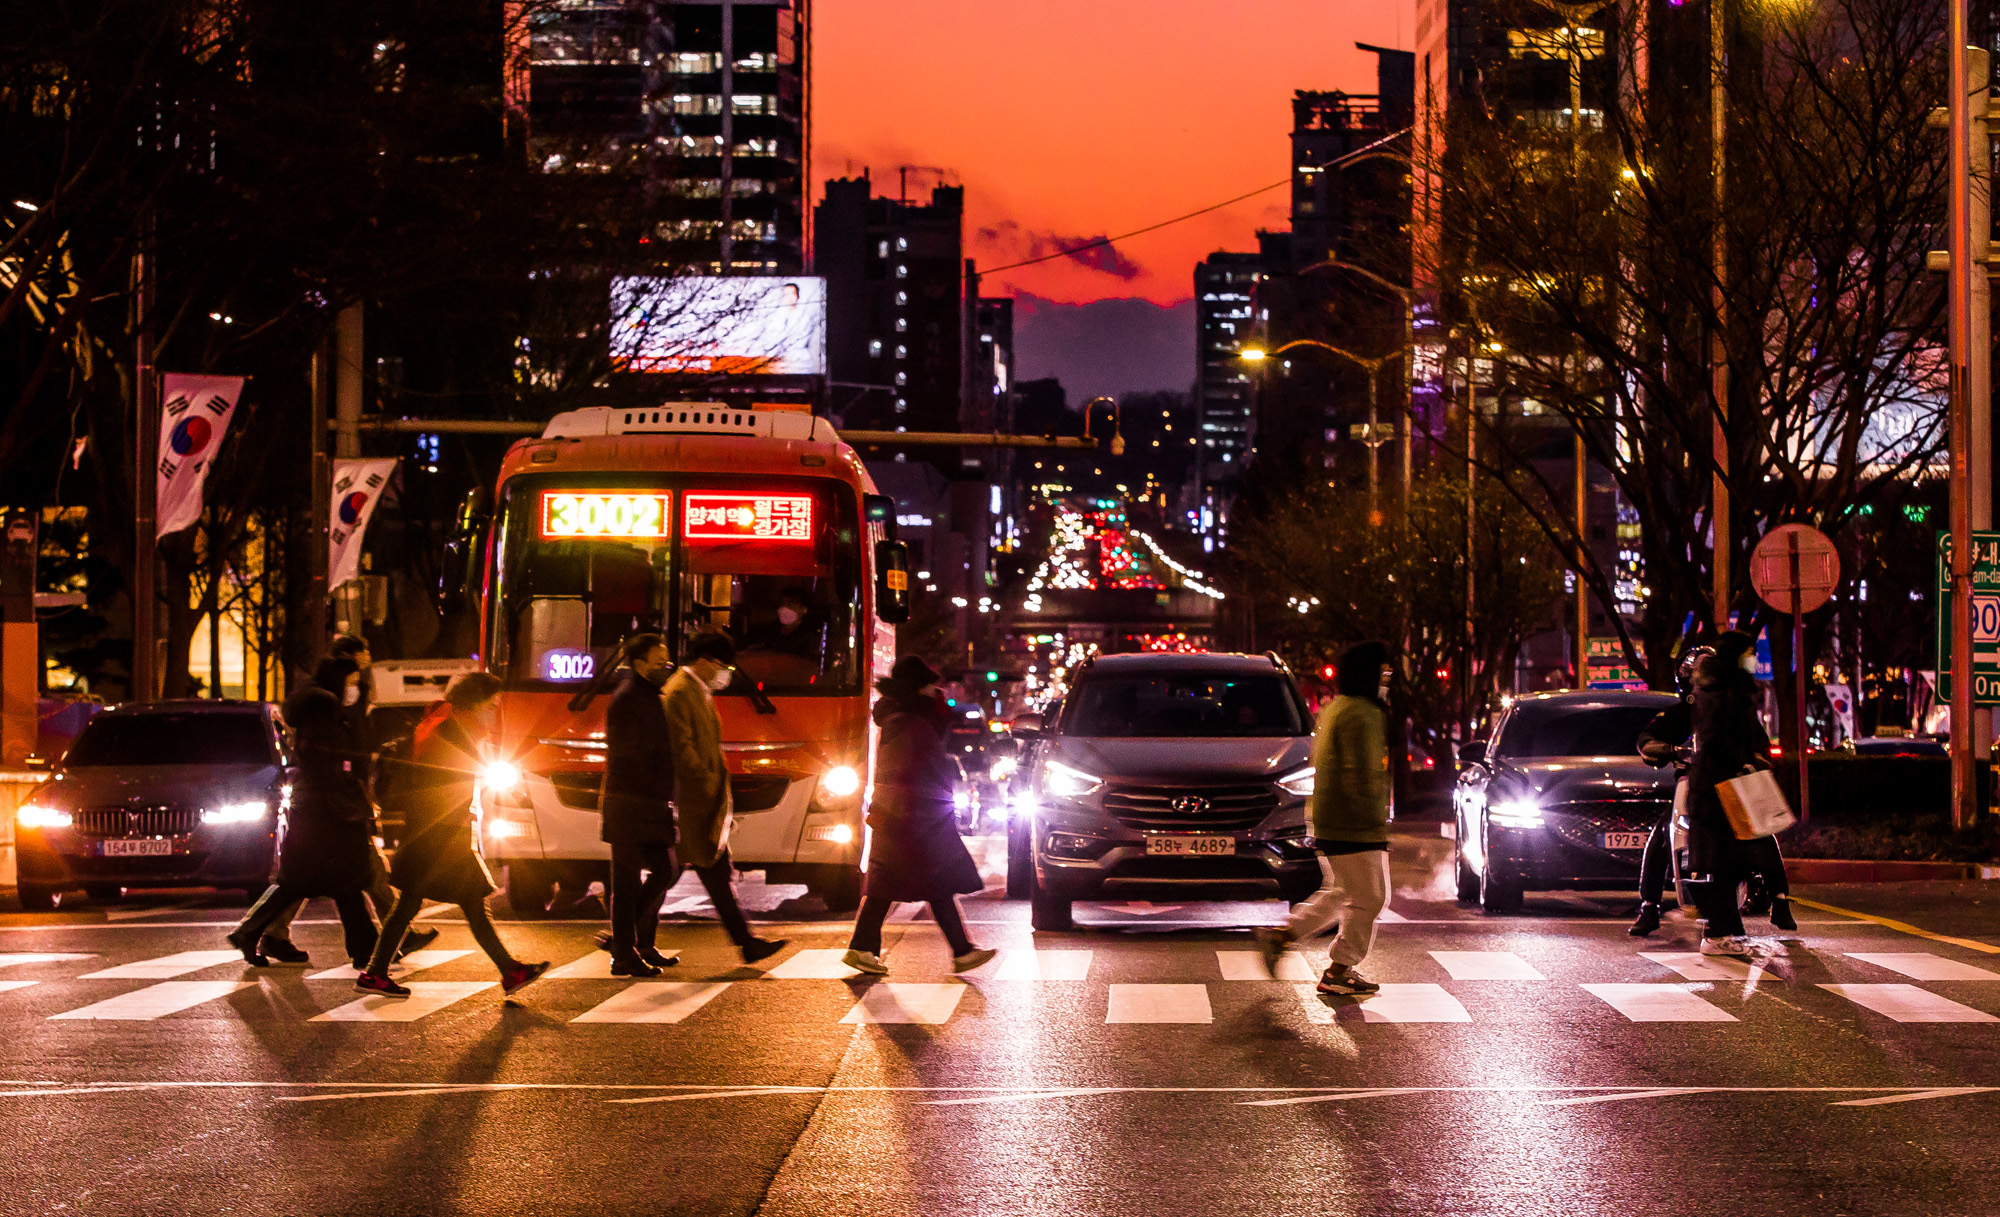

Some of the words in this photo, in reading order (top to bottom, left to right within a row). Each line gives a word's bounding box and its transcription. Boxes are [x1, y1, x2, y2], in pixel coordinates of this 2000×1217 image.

[551, 496, 660, 535] 3002
[689, 506, 745, 526] 양재역
[753, 500, 807, 518] 월드컵
[753, 518, 808, 536] 경기장
[549, 653, 594, 679] 3002
[1189, 839, 1227, 853] 4689
